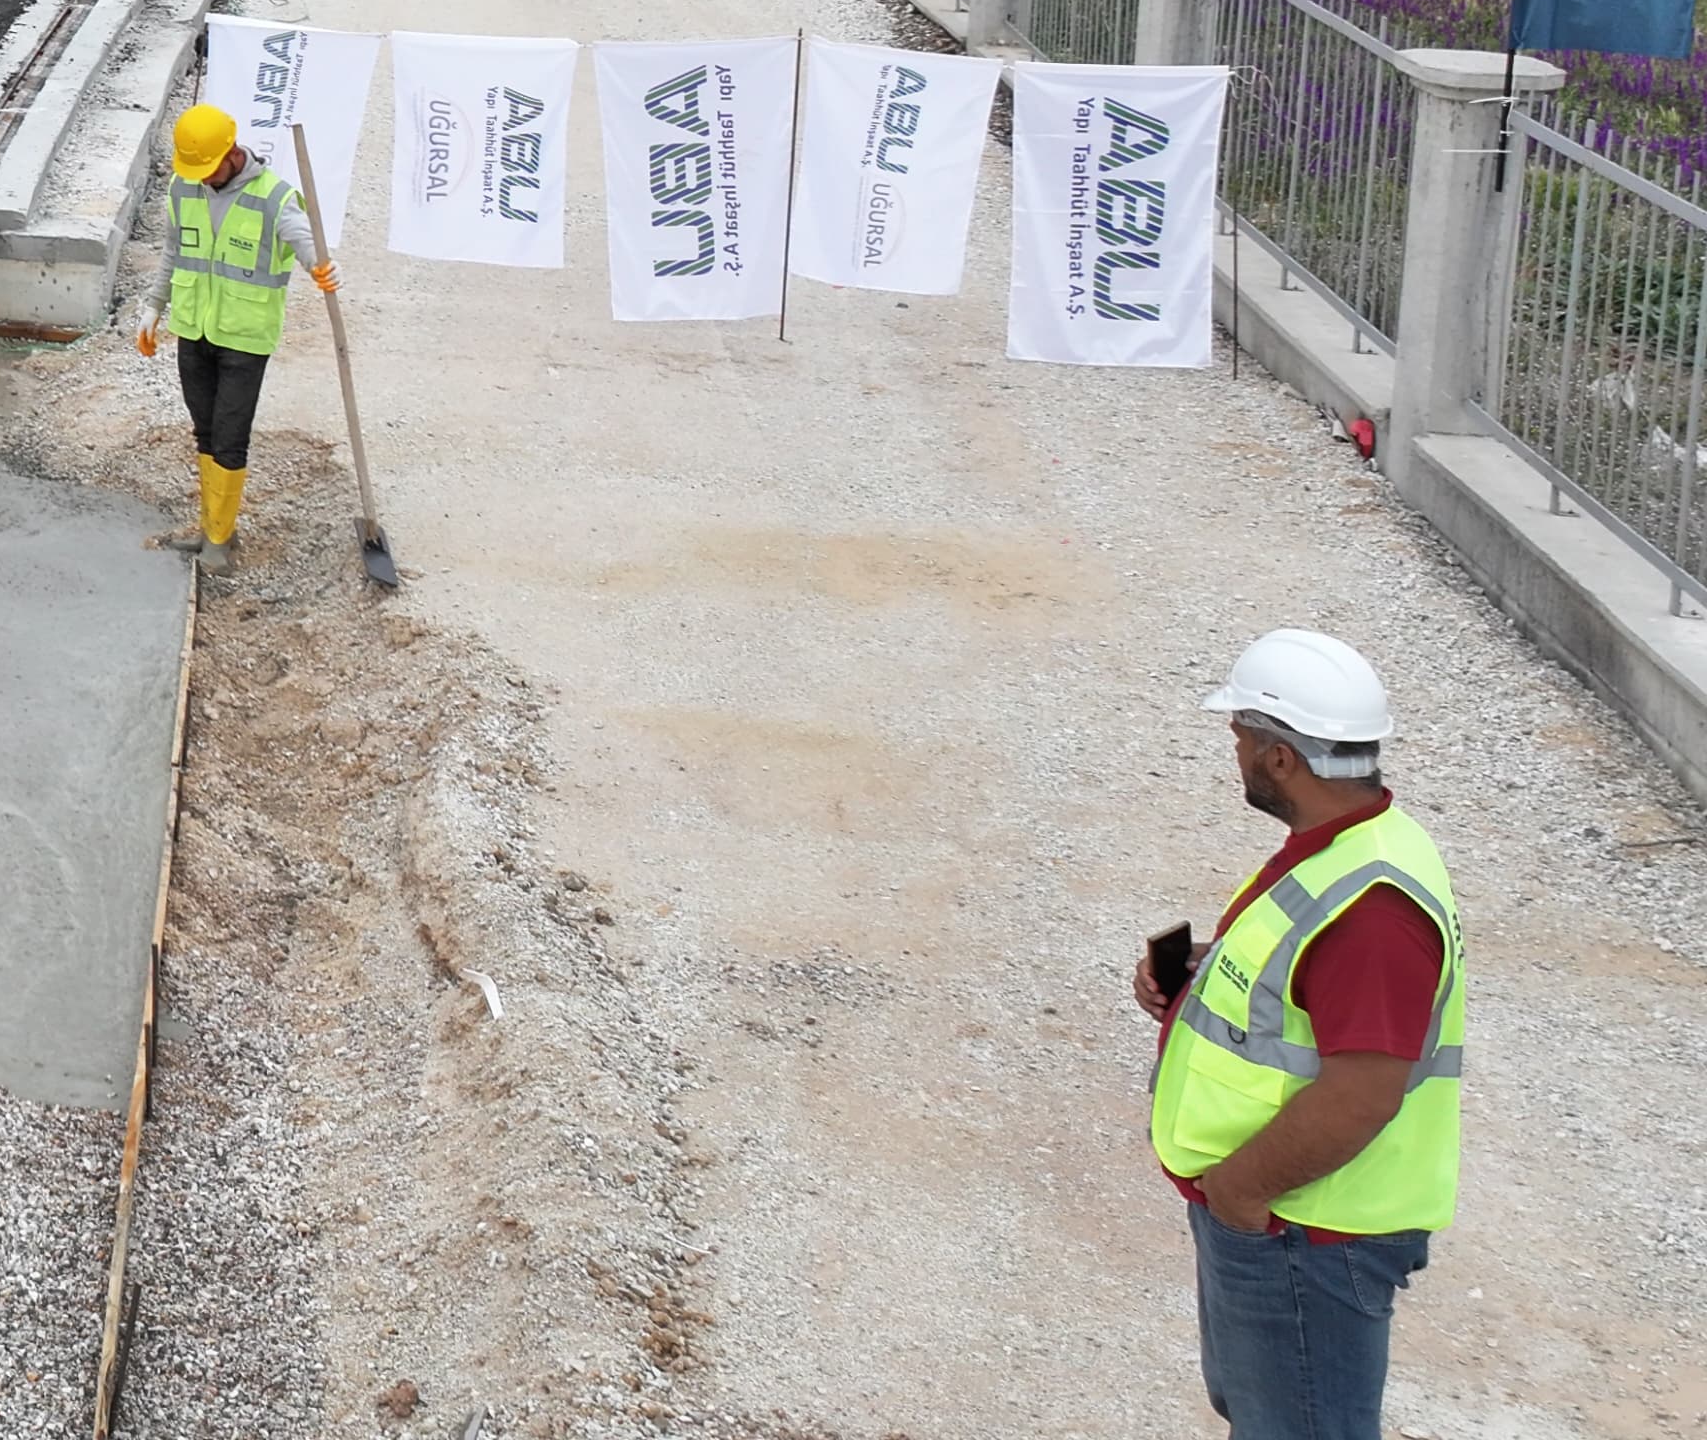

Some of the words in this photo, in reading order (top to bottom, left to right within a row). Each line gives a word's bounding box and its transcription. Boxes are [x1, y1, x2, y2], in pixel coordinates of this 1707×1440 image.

[1073, 97, 1096, 134] Yapı
[425, 99, 459, 203] UĞURSAL
[1070, 144, 1092, 219] Taahhüt
[863, 182, 895, 268] UĞURSAL
[1066, 223, 1092, 280] İnşaat
[1066, 284, 1086, 321] A.Ş.
